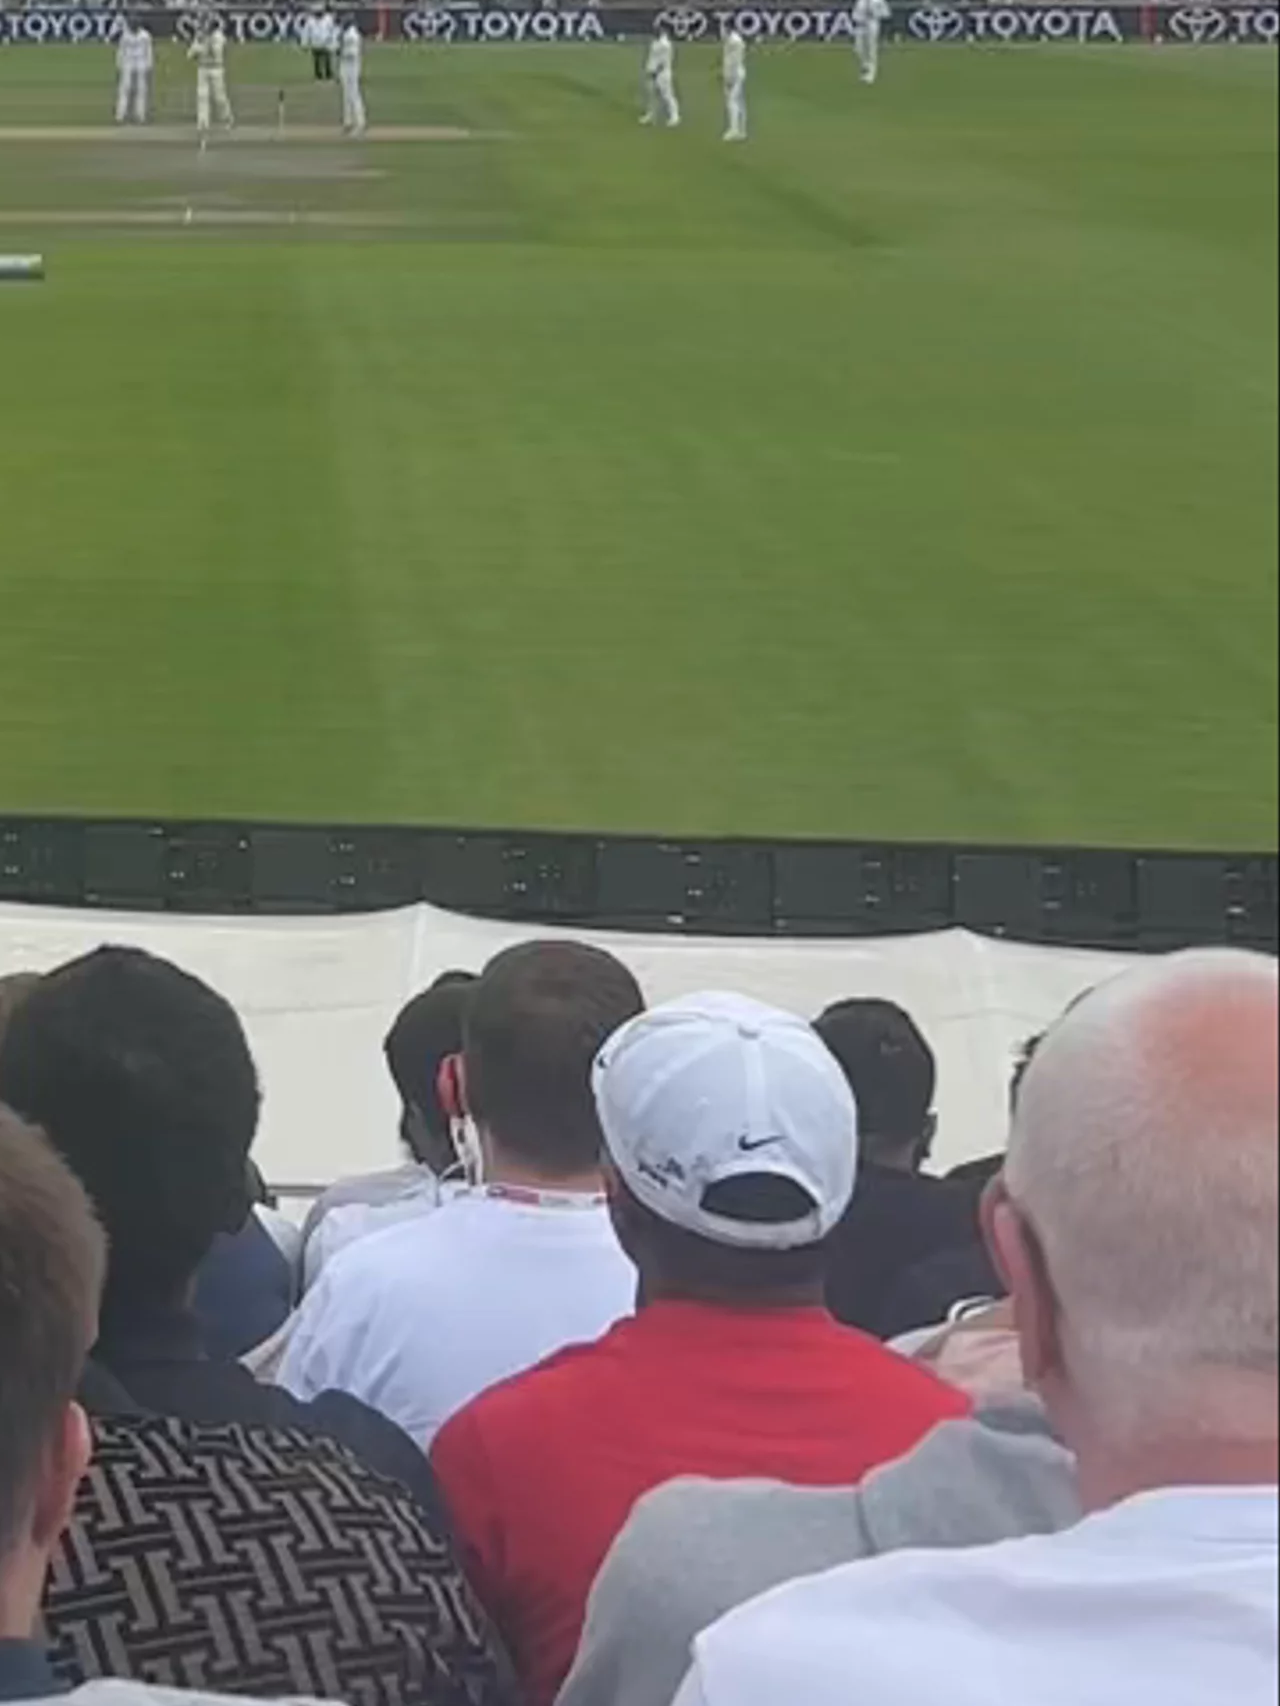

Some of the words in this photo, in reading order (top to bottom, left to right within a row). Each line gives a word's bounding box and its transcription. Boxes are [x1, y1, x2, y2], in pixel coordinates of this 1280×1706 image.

[5, 12, 129, 40] TOYOTA
[462, 10, 605, 37] TOYOTA
[714, 10, 854, 37] TOYOTA
[969, 10, 1121, 37] TOYOTA
